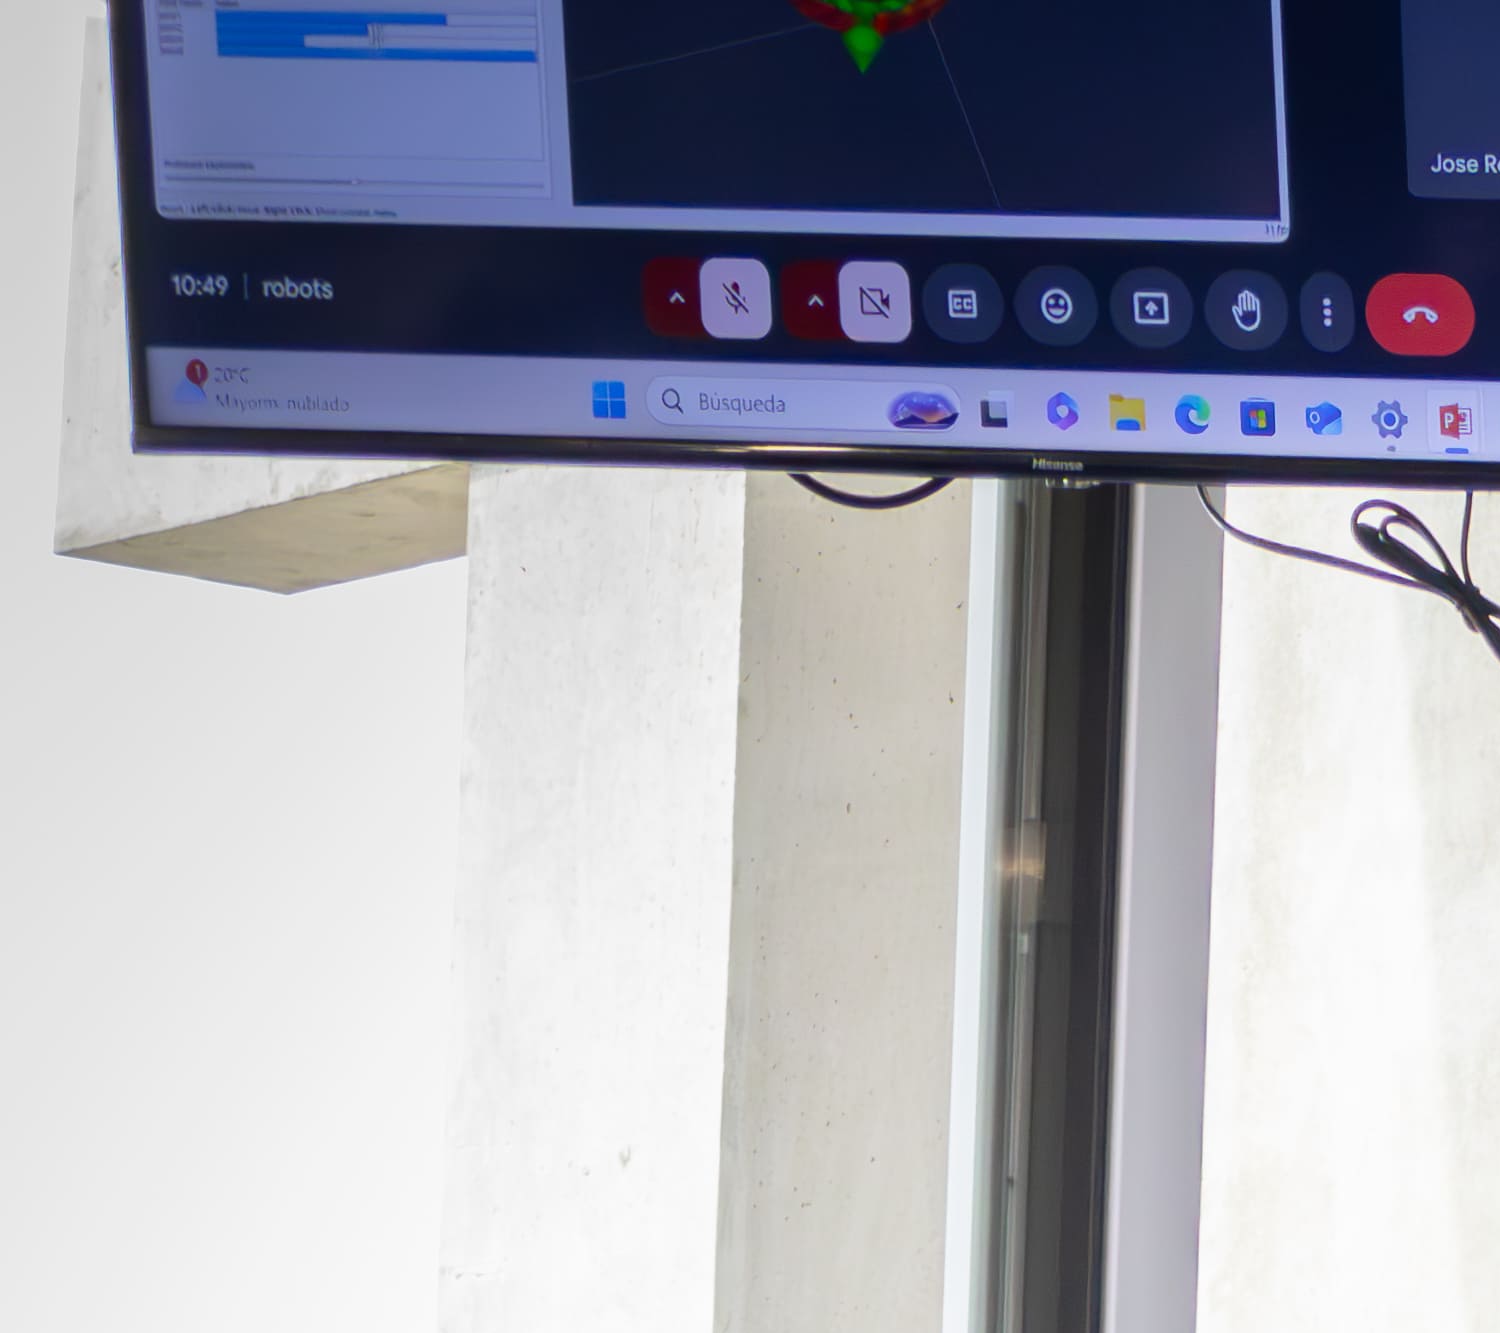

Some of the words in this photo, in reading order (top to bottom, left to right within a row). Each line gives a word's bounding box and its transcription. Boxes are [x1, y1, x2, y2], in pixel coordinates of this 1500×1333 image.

[1430, 152, 1479, 173] Jose
[170, 273, 229, 296] 10:49
[262, 276, 334, 300] robots
[699, 392, 786, 416] Búsqueda
